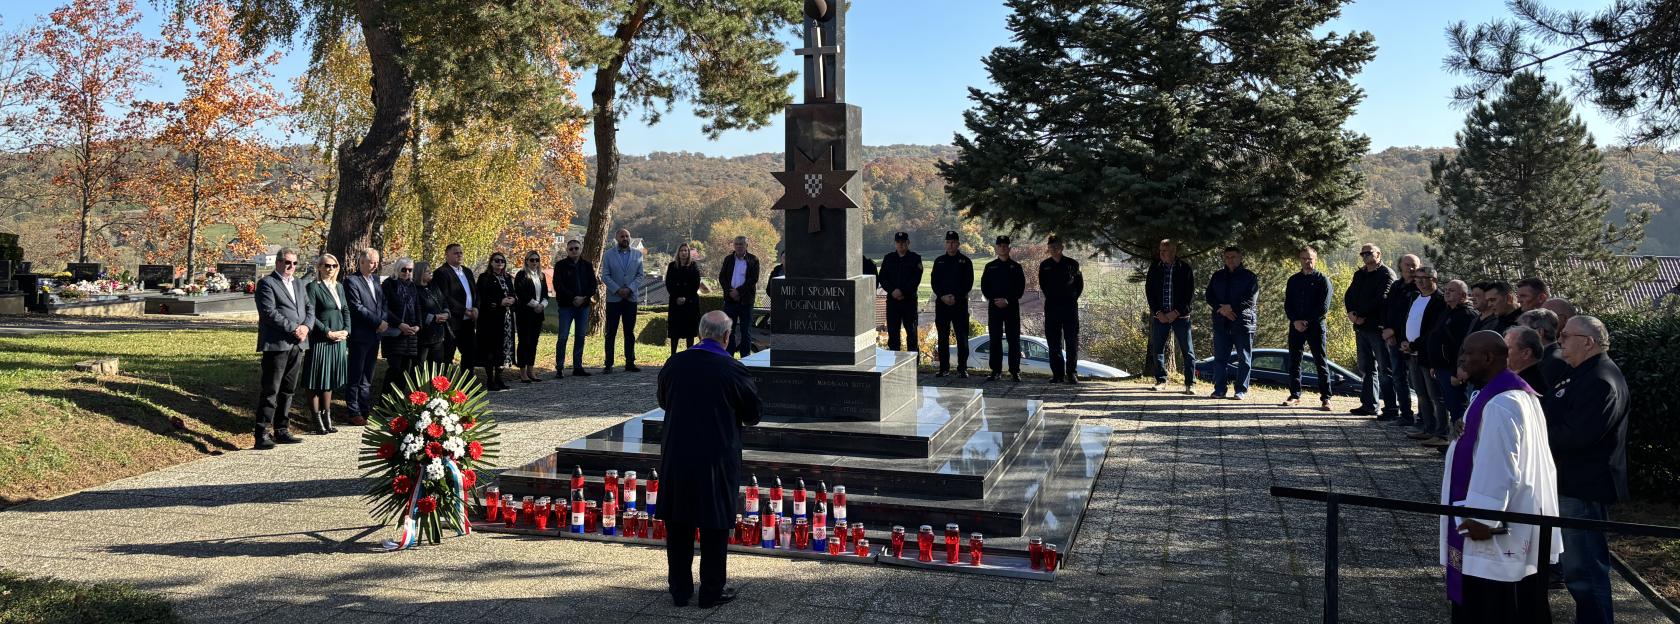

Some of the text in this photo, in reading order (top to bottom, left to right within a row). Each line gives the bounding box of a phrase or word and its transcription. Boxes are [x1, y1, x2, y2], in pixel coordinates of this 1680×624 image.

[780, 285, 797, 296] MIR
[807, 286, 846, 297] SPOMEN
[785, 299, 842, 311] POGINULIMA
[789, 320, 837, 332] HRVATSKU
